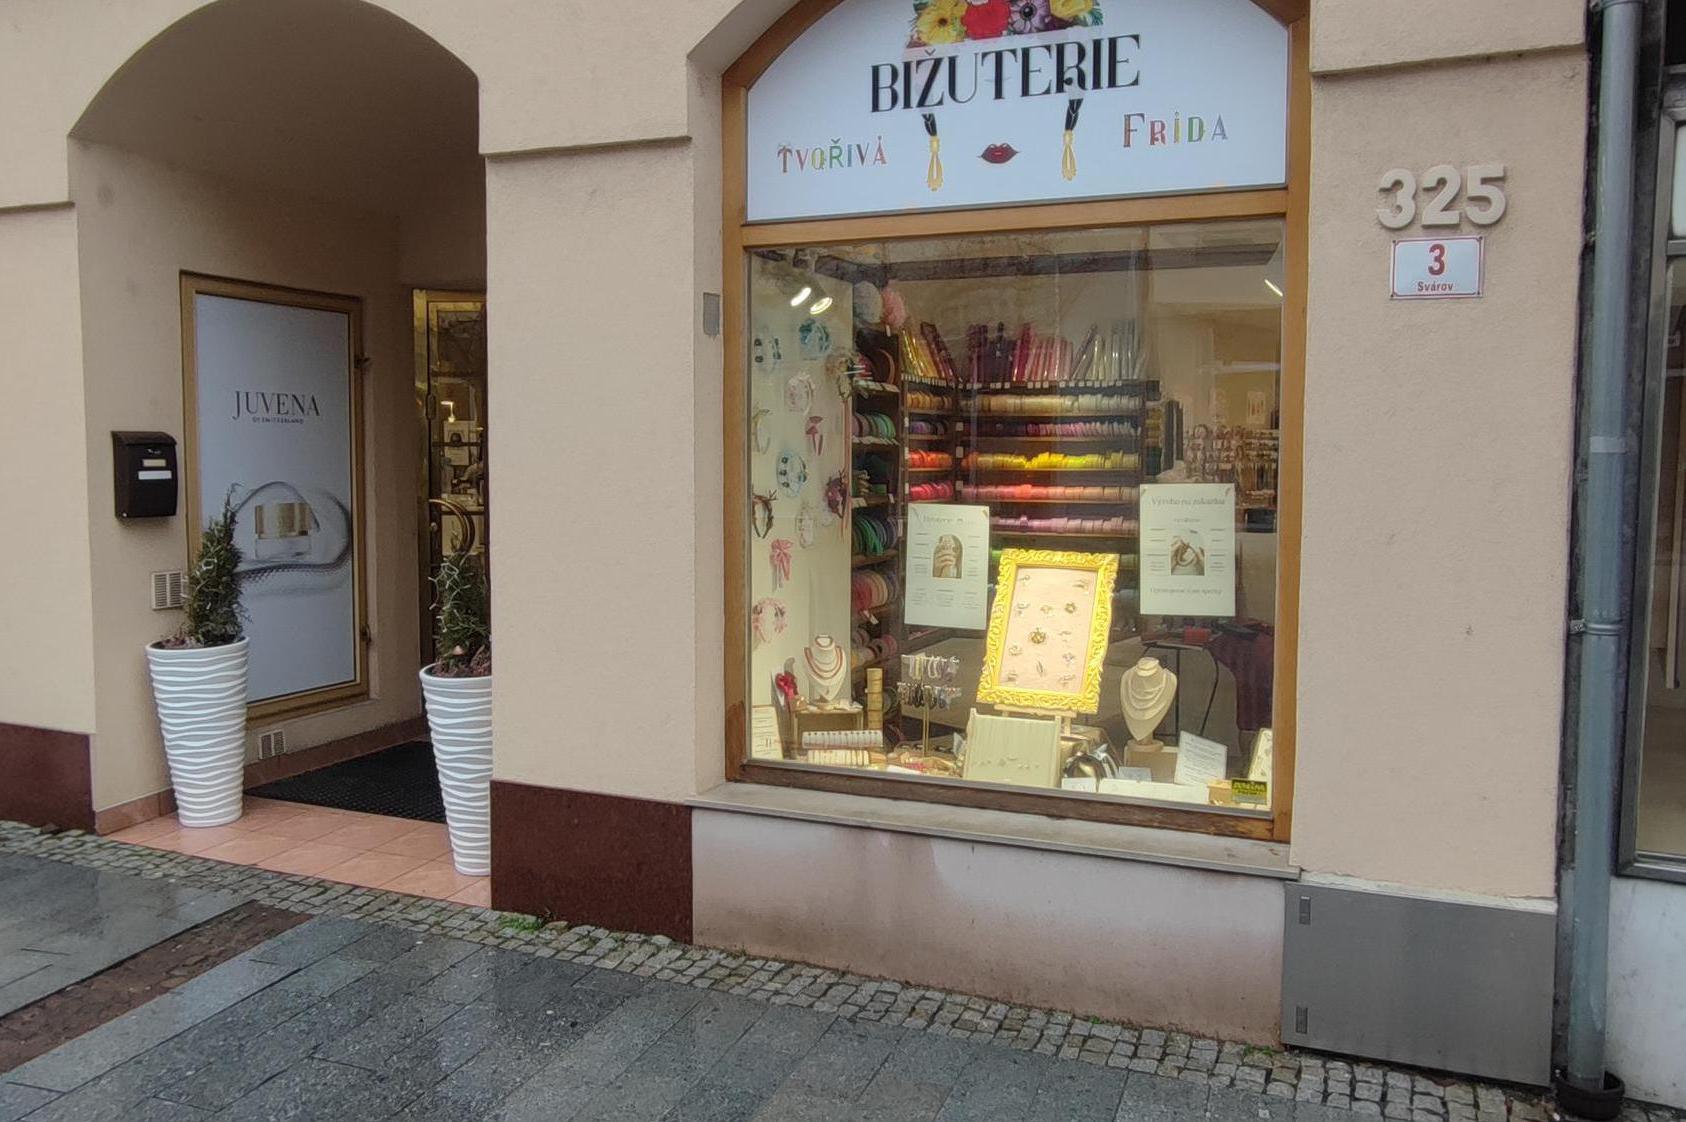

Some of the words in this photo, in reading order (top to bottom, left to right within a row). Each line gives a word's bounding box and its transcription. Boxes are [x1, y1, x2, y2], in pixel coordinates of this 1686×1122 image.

[870, 34, 1142, 113] BIŽUTERIE
[1376, 164, 1508, 229] 325
[1428, 244, 1446, 276] 3
[1417, 281, 1453, 292] Svárov
[232, 391, 320, 420] JUVENA
